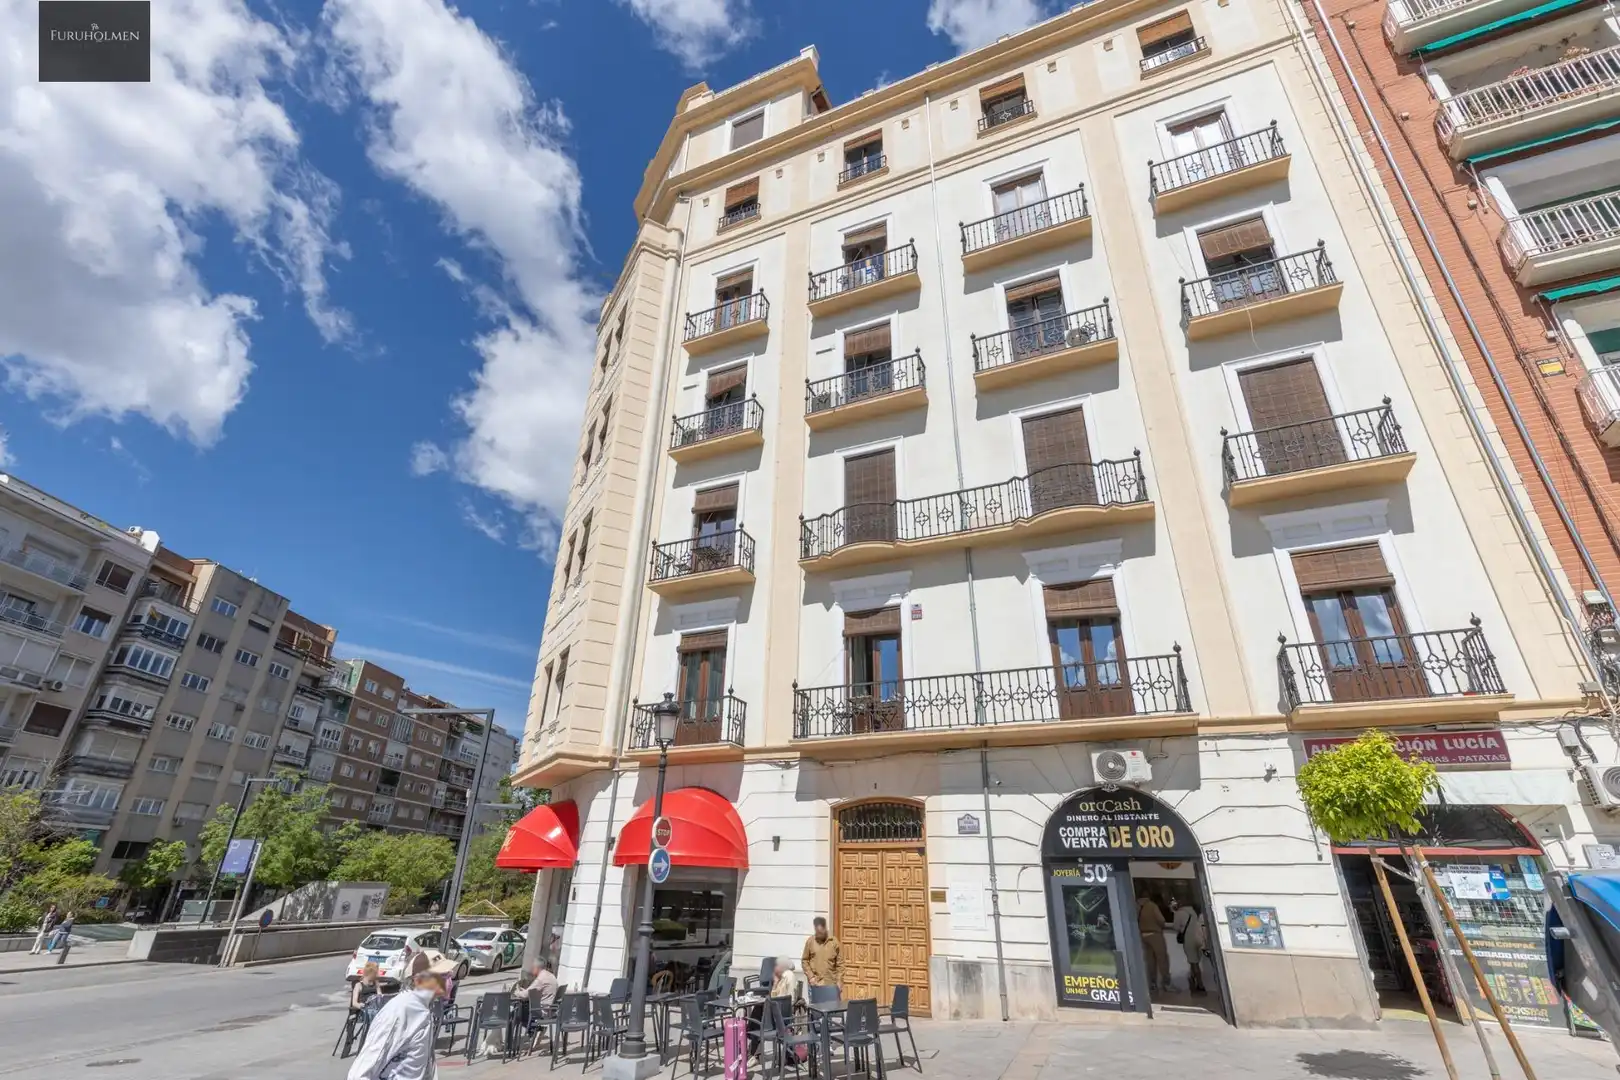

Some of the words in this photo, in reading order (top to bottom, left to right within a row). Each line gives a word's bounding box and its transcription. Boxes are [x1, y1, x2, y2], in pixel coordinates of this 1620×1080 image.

[1443, 734, 1500, 751] LUCÍA
[1458, 753, 1508, 763] PATATAS
[1066, 814, 1100, 822] DINERO
[1114, 813, 1160, 821] INSTANTE
[1059, 826, 1108, 838] COMPRA
[1108, 825, 1133, 848] DE
[1136, 825, 1175, 848] ORO
[1061, 838, 1108, 849] VENTA
[1053, 868, 1080, 877] JOYERÍA
[1083, 863, 1113, 883] 50%
